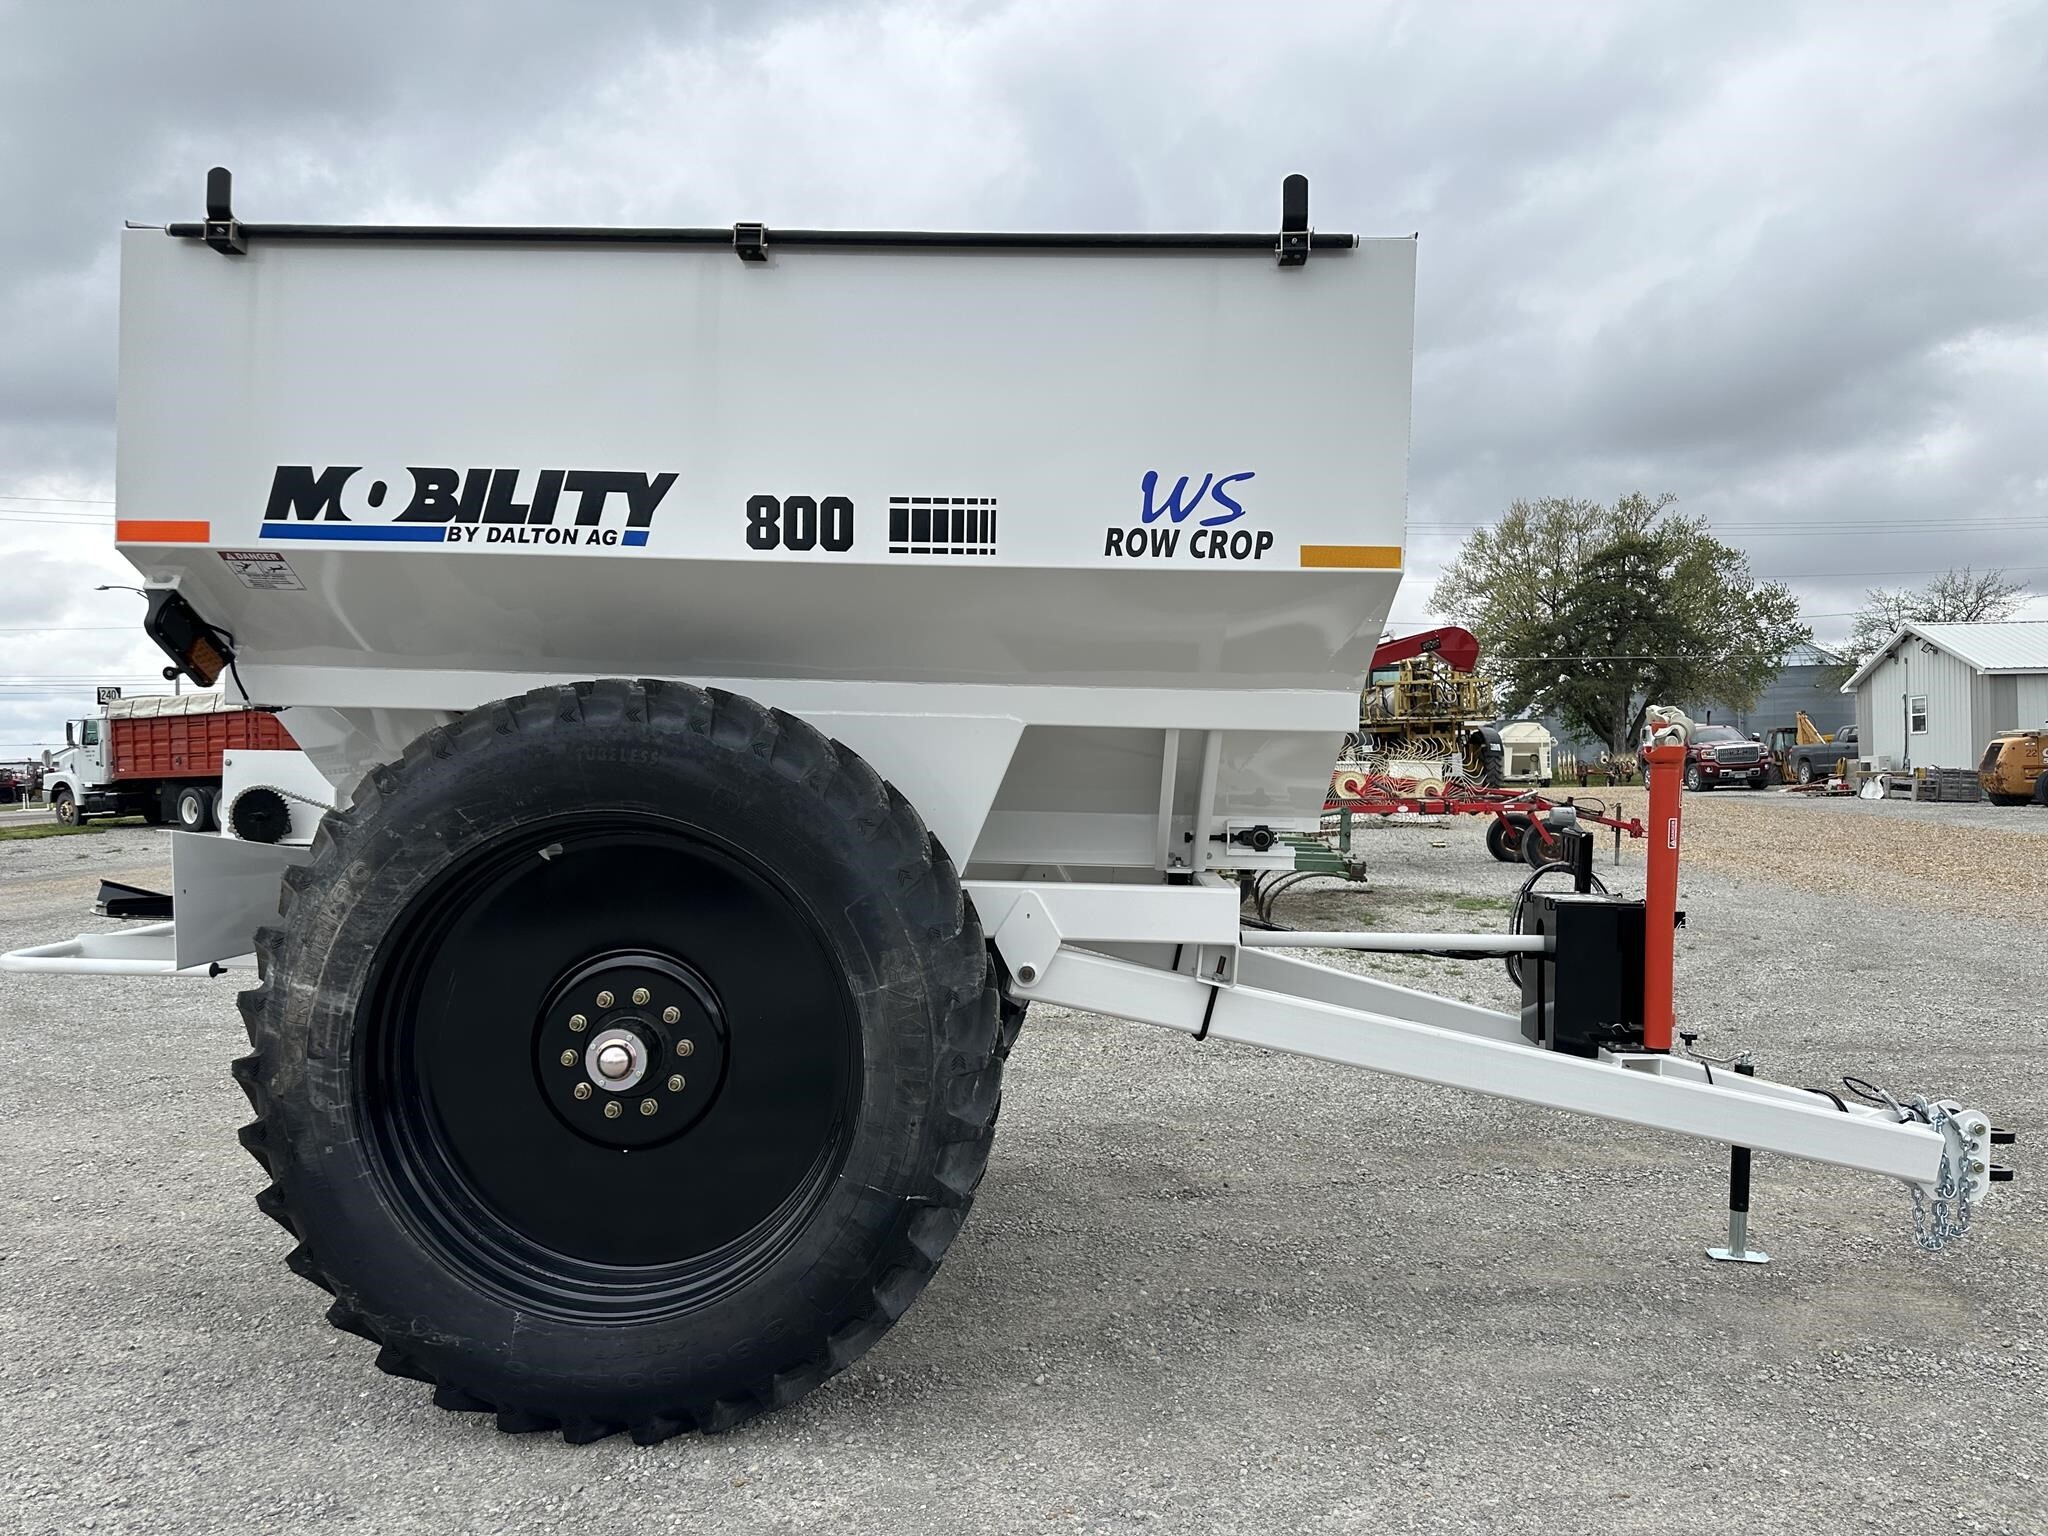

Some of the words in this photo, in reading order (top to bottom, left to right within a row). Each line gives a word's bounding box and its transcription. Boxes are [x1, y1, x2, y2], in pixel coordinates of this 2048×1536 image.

[263, 465, 679, 527] MOBILITY
[1142, 470, 1254, 527] WS
[446, 526, 480, 543] BY
[486, 527, 579, 545] DALTON
[585, 529, 618, 546] AG
[746, 494, 854, 552] 800
[236, 552, 279, 561] DANGER
[1104, 527, 1181, 558] ROW
[1189, 529, 1274, 560] CROP
[101, 690, 117, 700] 240
[2025, 749, 2038, 758] 22
